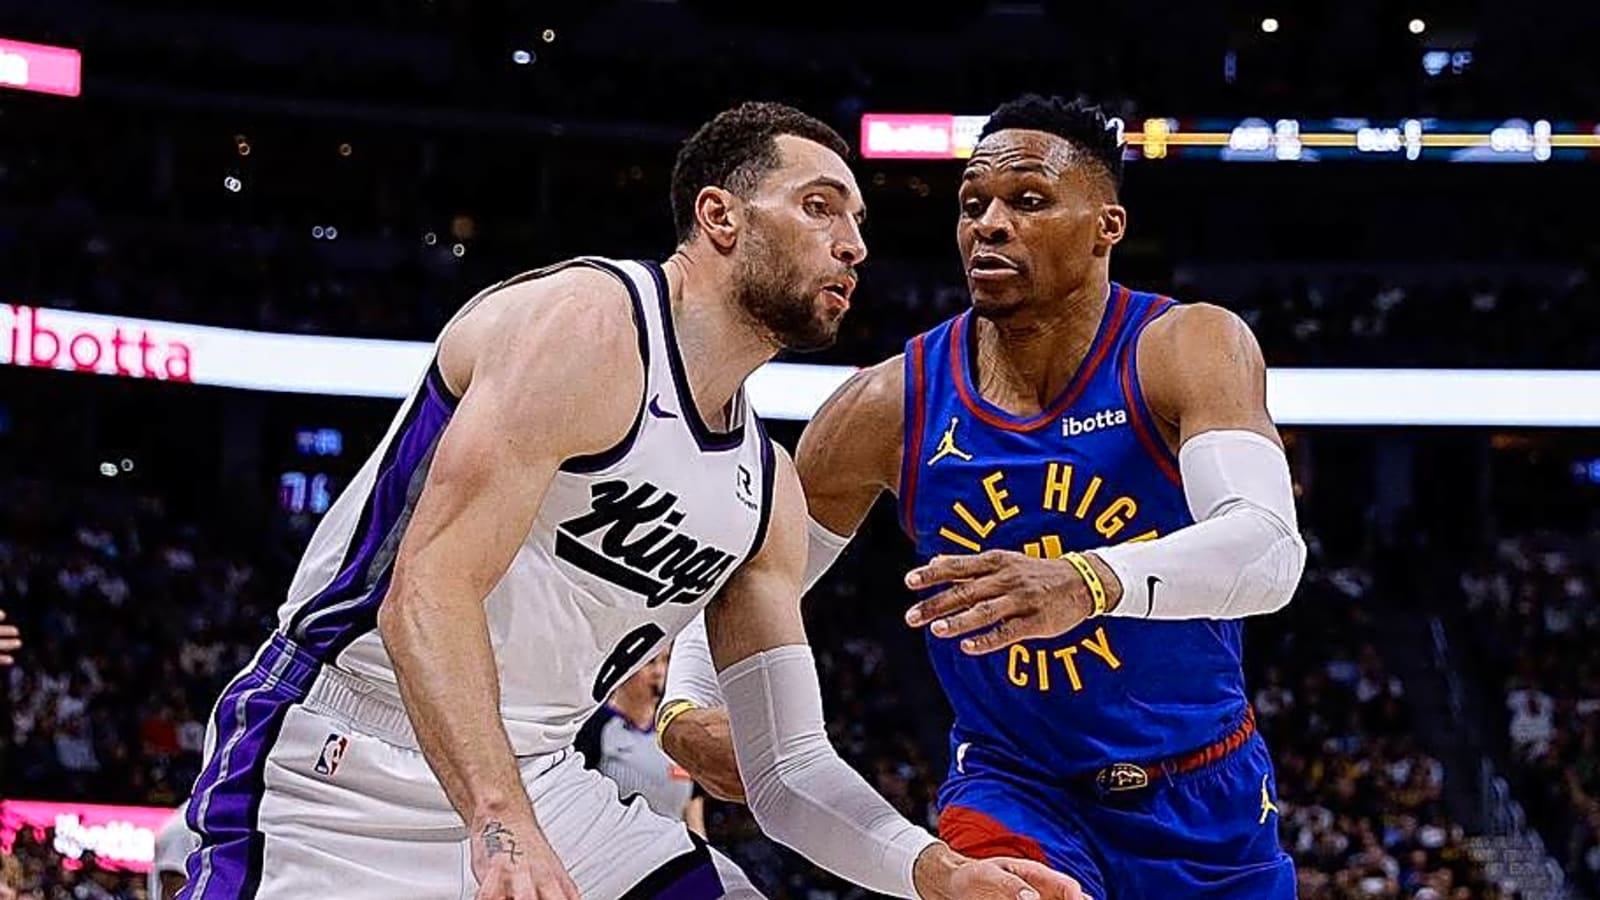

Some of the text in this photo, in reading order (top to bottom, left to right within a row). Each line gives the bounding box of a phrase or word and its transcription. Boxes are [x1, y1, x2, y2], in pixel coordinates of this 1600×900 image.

[11, 302, 192, 382] ibotta
[1062, 410, 1126, 436] ibotta
[556, 480, 737, 608] Kings
[939, 463, 1158, 552] ILE HIG
[592, 622, 666, 703] 8
[1008, 627, 1121, 691] CITY
